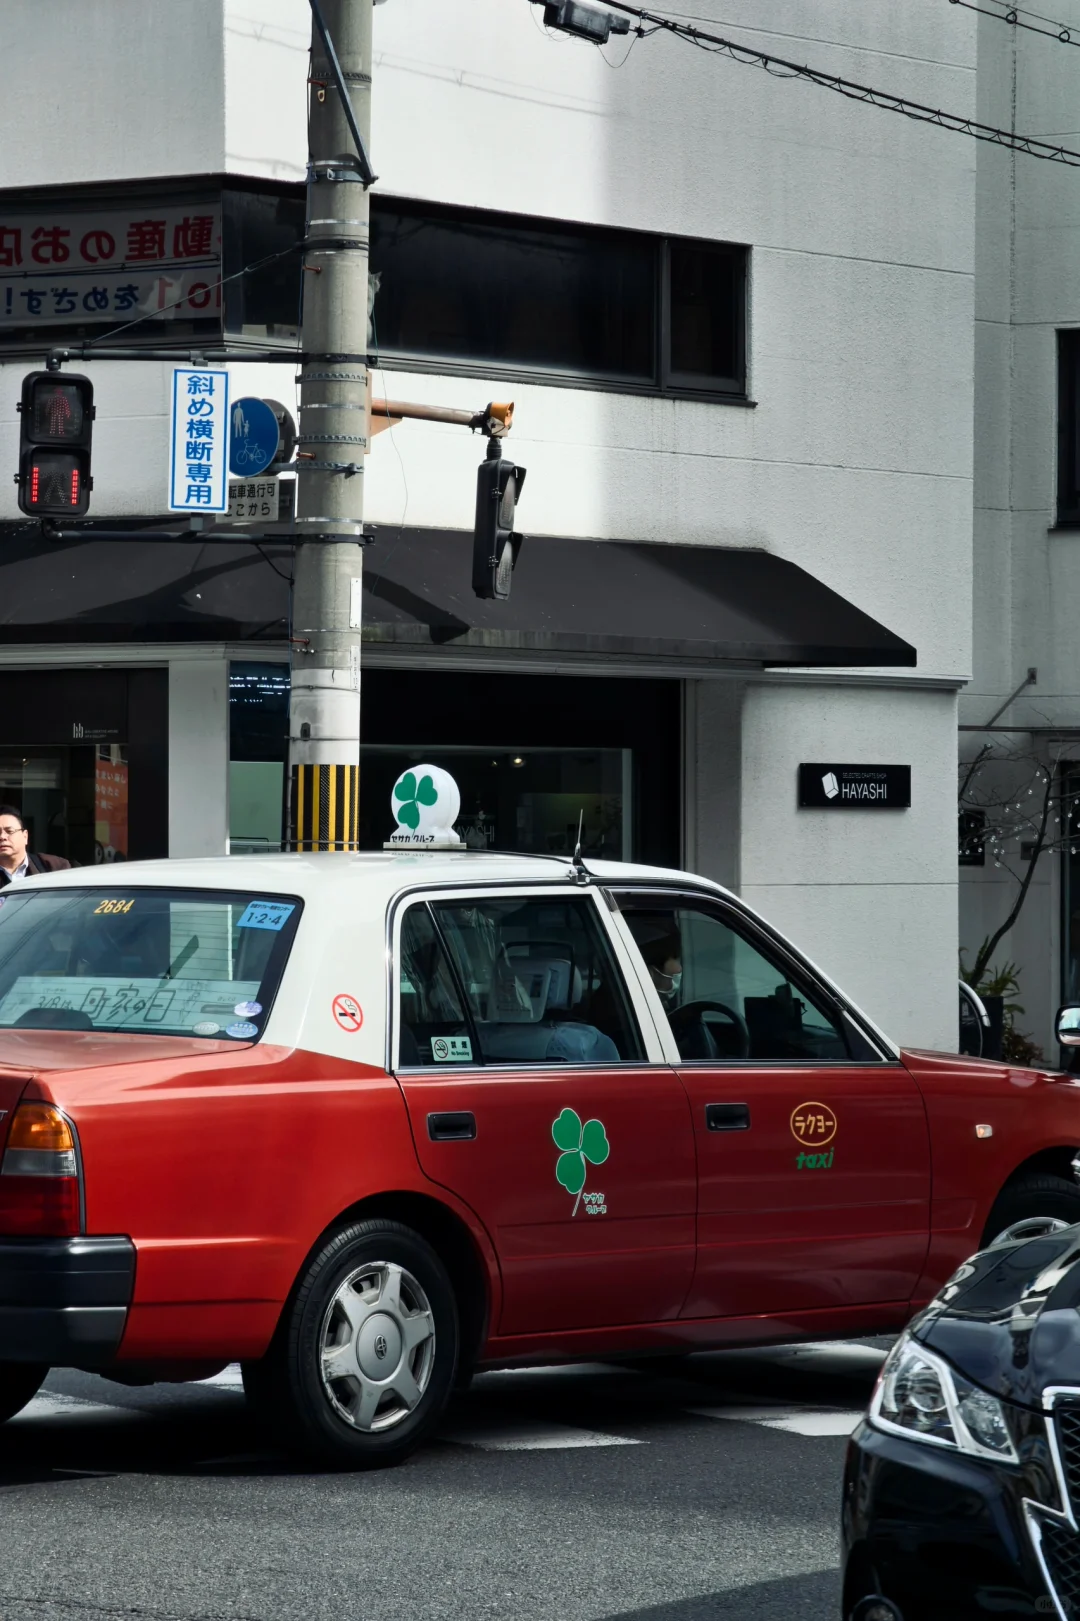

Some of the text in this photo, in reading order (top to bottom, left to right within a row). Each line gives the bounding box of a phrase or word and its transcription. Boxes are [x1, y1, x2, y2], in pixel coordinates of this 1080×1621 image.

[185, 375, 215, 505] 斜め横断専用
[842, 783, 887, 799] HAYASHI
[94, 899, 135, 914] 2684
[795, 1113, 834, 1136] ラクヨー
[796, 1147, 834, 1169] taxi
